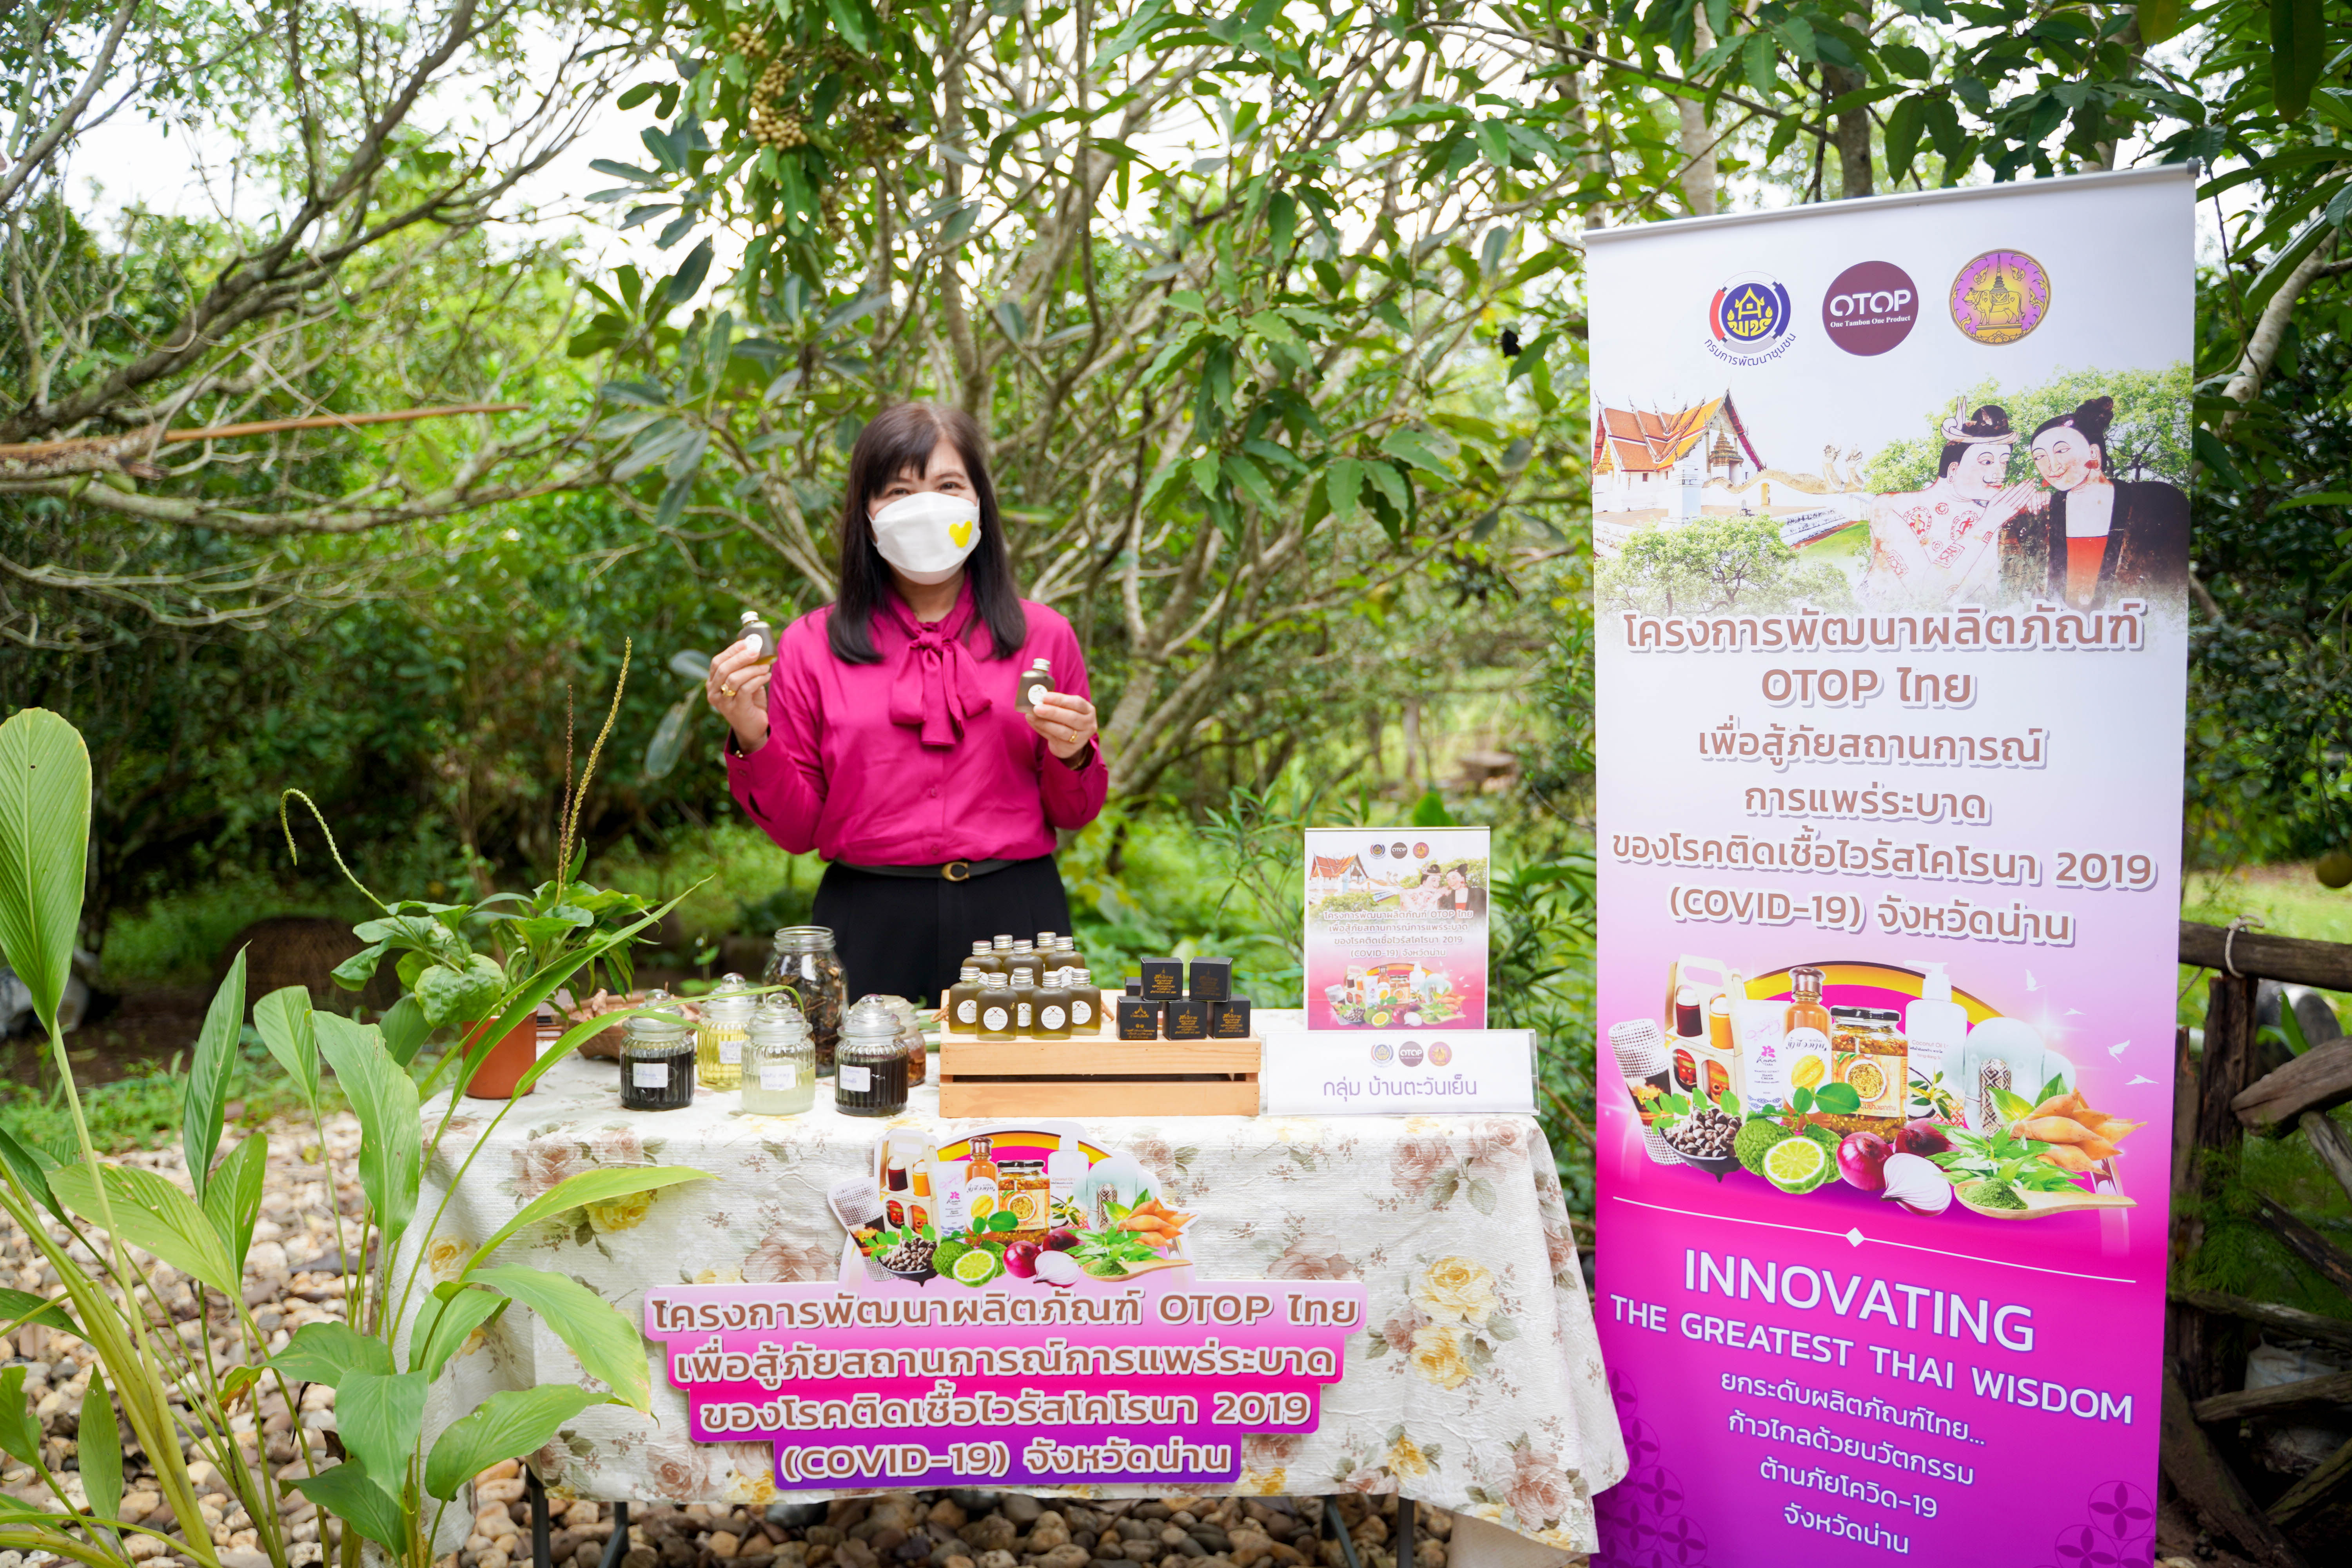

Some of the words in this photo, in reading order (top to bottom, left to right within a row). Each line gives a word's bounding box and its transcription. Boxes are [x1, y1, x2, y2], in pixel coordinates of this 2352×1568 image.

[1830, 290, 1911, 317] OTOP
[1704, 333, 1796, 366] กรมการพัฒนาชุมชน
[1624, 602, 2142, 649] โครงการพัฒนาผลิตภัณฑ์
[1762, 669, 1878, 701] OTOP
[1898, 668, 1973, 705] ไทย
[1699, 717, 2043, 766] เพื่อสู้ภัยสถานการณ์
[1746, 782, 1986, 820] การแพร่ระบาด
[1613, 826, 2036, 880] ของโรคติดเชื้อไวรัสโคโรนา
[2056, 852, 2152, 884] 2019
[1324, 911, 1427, 919] โครงการพัฒนาผลิตภัณฑ์
[1329, 922, 1468, 934] เพื่อสู้ภัยสถานการณ์การแพร่ระบาด
[1671, 887, 1860, 930] (COVID-19)
[1879, 895, 2069, 941] จังหวัดน่าน
[1334, 934, 1438, 944] ของโรคติดเชื้อไวรัสโคโรนา
[1351, 949, 1398, 958] (COVID-19)
[1403, 948, 1446, 956] จังหวัดน่าน
[1324, 1076, 1360, 1102] กลุ่ม
[1369, 1074, 1477, 1096] บ้านตะวันเย็น
[653, 1289, 1142, 1330] โครงการพัฒนาผลิตภัณฑ์
[1157, 1295, 1272, 1324] OTOP
[1289, 1295, 1359, 1326] ไทย
[1686, 1249, 2034, 1352] INNOVATING
[675, 1336, 1335, 1390] เพื่อสู้ภัยสถานการณ์การแพร่ระบาด
[1611, 1294, 1667, 1333] THE
[1681, 1312, 1853, 1367] GREATEST
[1869, 1346, 1954, 1389] THAI
[1972, 1367, 2132, 1424] WISDOM
[701, 1383, 1197, 1433] ของโรคติดเชื้อไวรัสโคโรนา
[1214, 1395, 1309, 1424] 2019
[1721, 1370, 1985, 1445] ยกระดับผลิตภัณฑ์ไทย...
[782, 1444, 1010, 1479] (COVID-19)
[1027, 1436, 1230, 1474] จังหวัดน่าน
[1730, 1411, 1974, 1486] ก้าวไกลด้วยนวัตกรรม
[1760, 1458, 1937, 1518] ต้านภัยโควิด-19
[1784, 1503, 1909, 1555] จังหวัดน่าน
